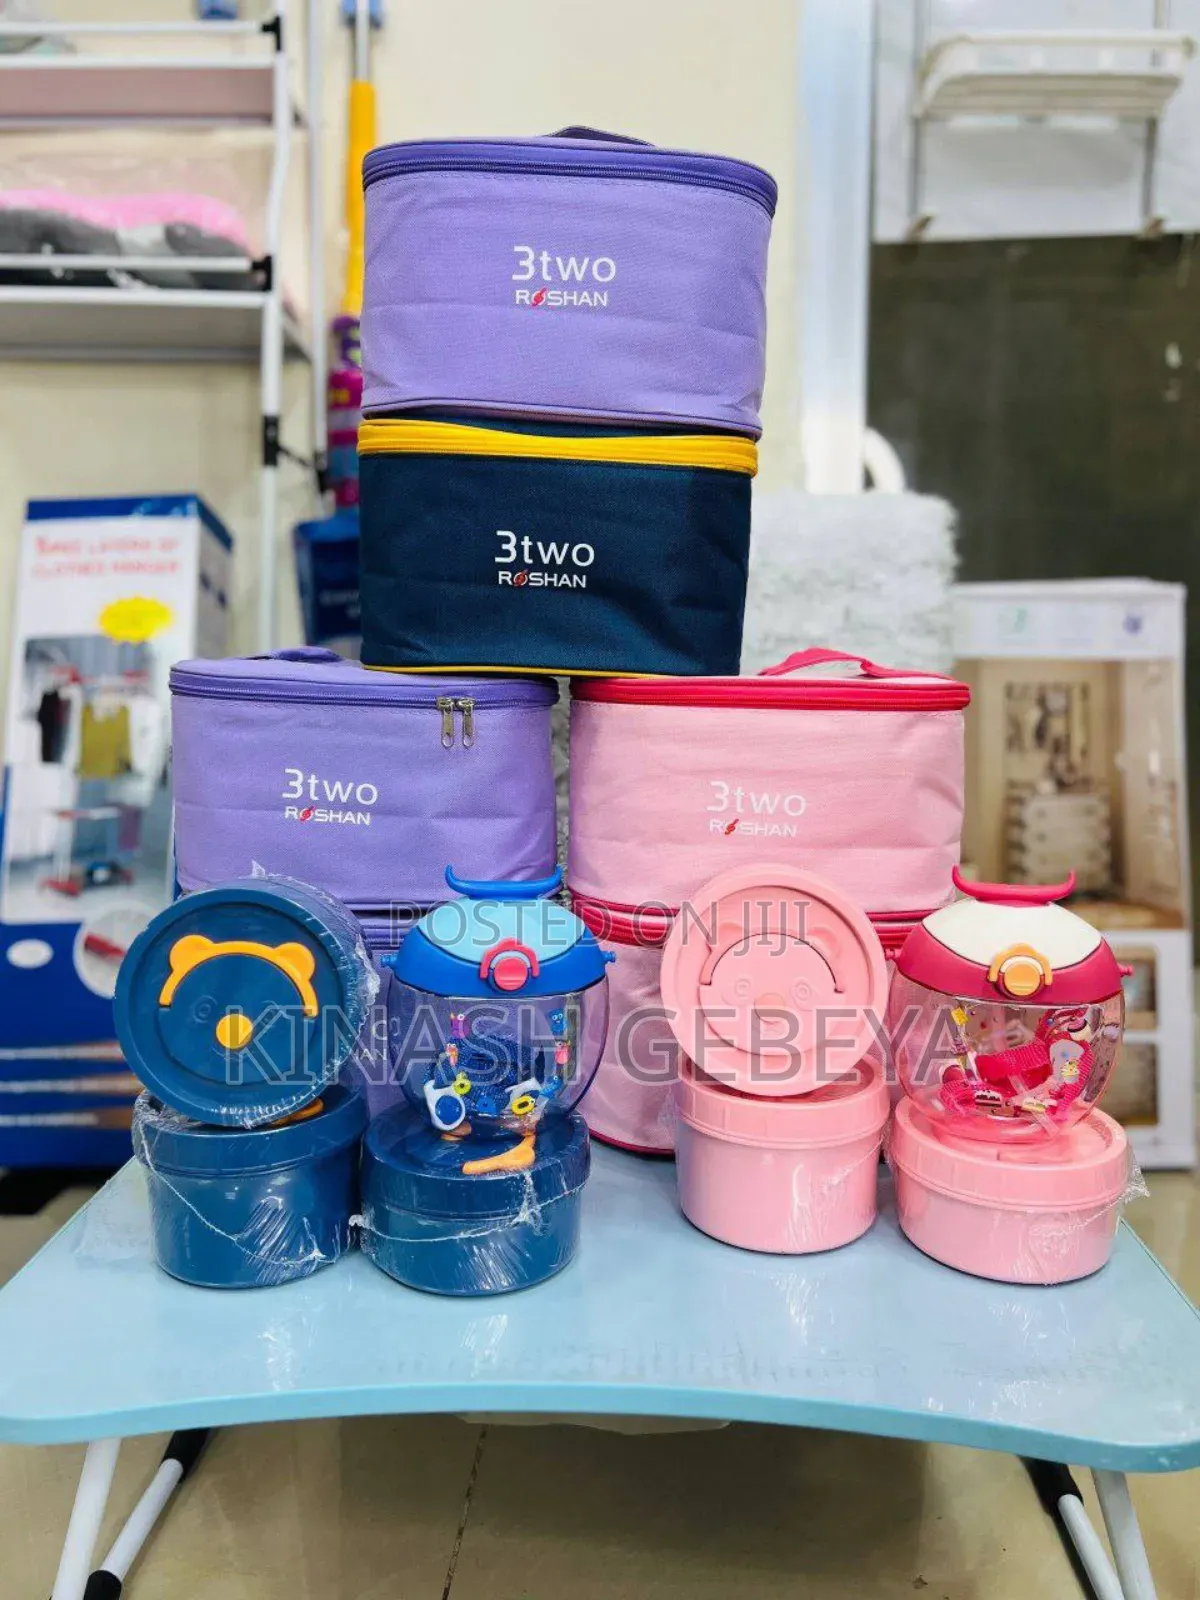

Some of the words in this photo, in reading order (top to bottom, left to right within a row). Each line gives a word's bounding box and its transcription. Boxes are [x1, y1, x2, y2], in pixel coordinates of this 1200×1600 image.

[511, 245, 617, 282] 3two
[514, 288, 608, 307] ROSHAN
[494, 530, 595, 567] 3two
[498, 569, 588, 588] ROSHAN
[282, 768, 378, 805] 3two
[706, 780, 807, 816] 3two
[284, 806, 372, 826] ROSHAN
